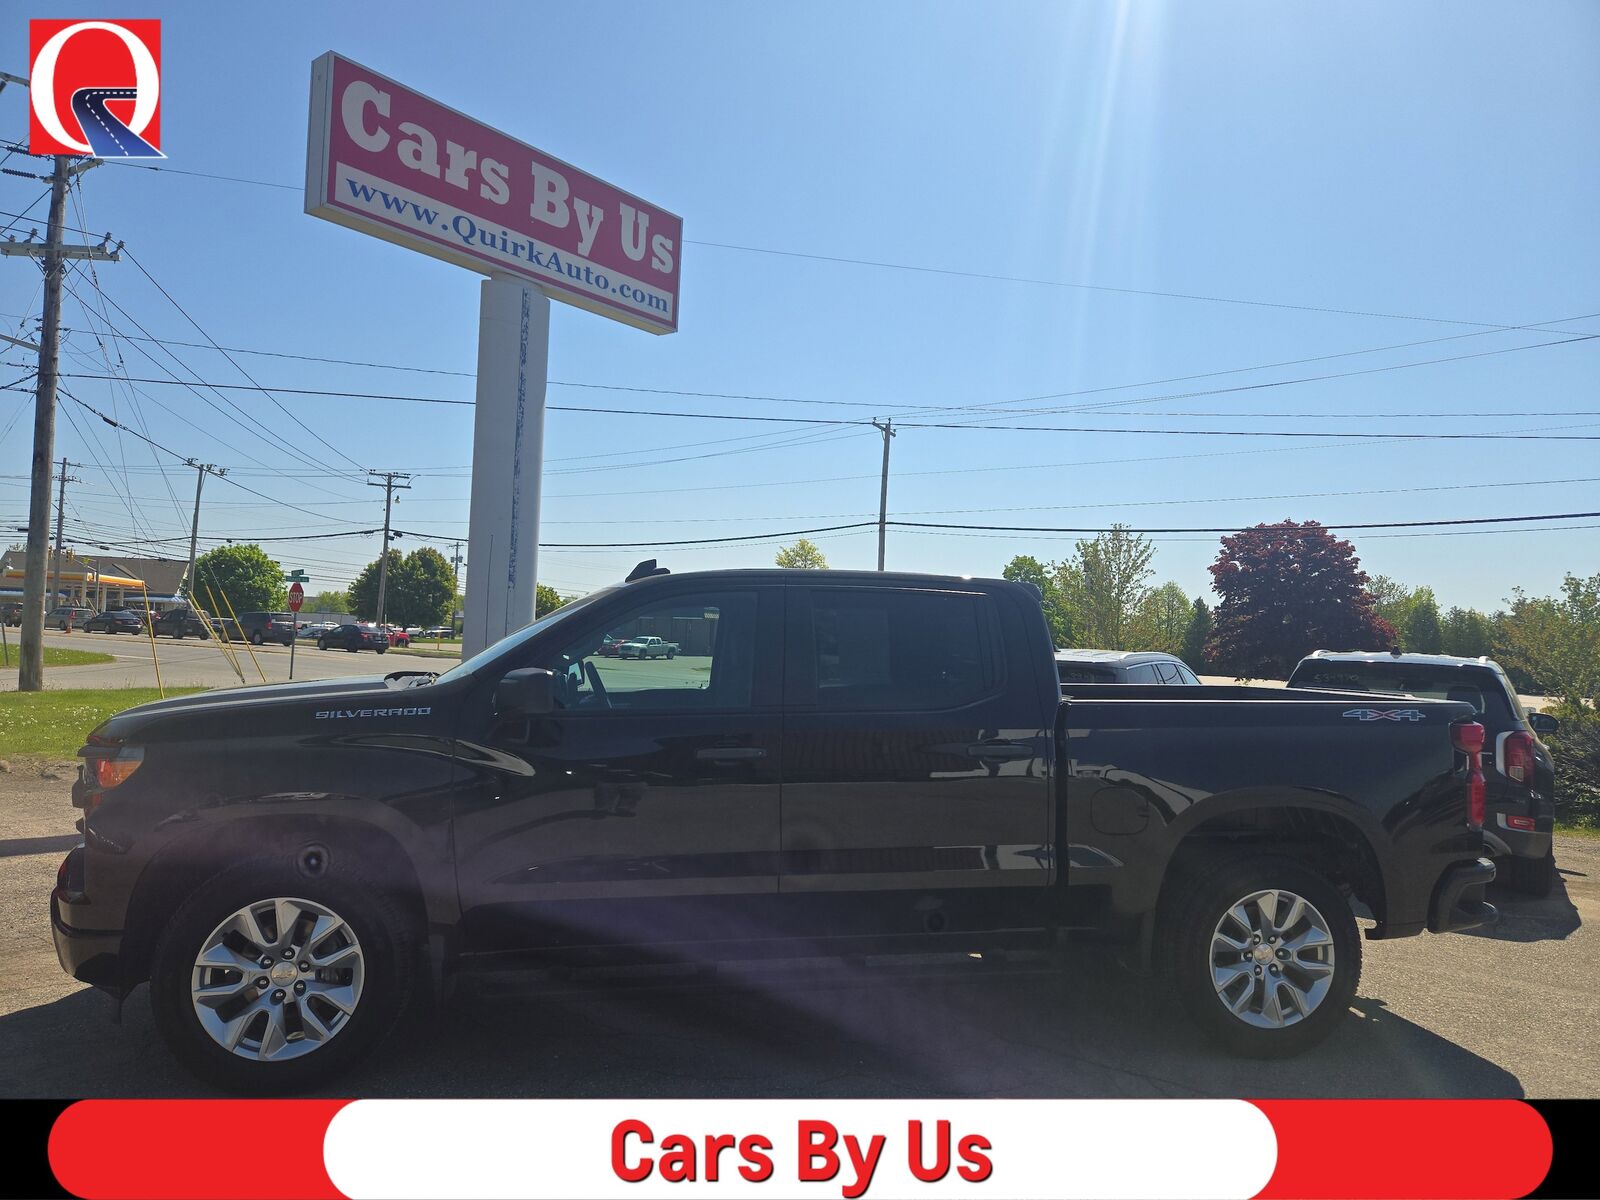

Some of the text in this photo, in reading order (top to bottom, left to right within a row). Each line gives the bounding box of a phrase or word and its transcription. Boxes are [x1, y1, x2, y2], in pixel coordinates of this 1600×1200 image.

[341, 80, 674, 274] Cars By Us
[346, 177, 669, 313] www.QuirkAuto.com
[289, 592, 303, 603] STOP
[315, 707, 431, 719] SILVERADO
